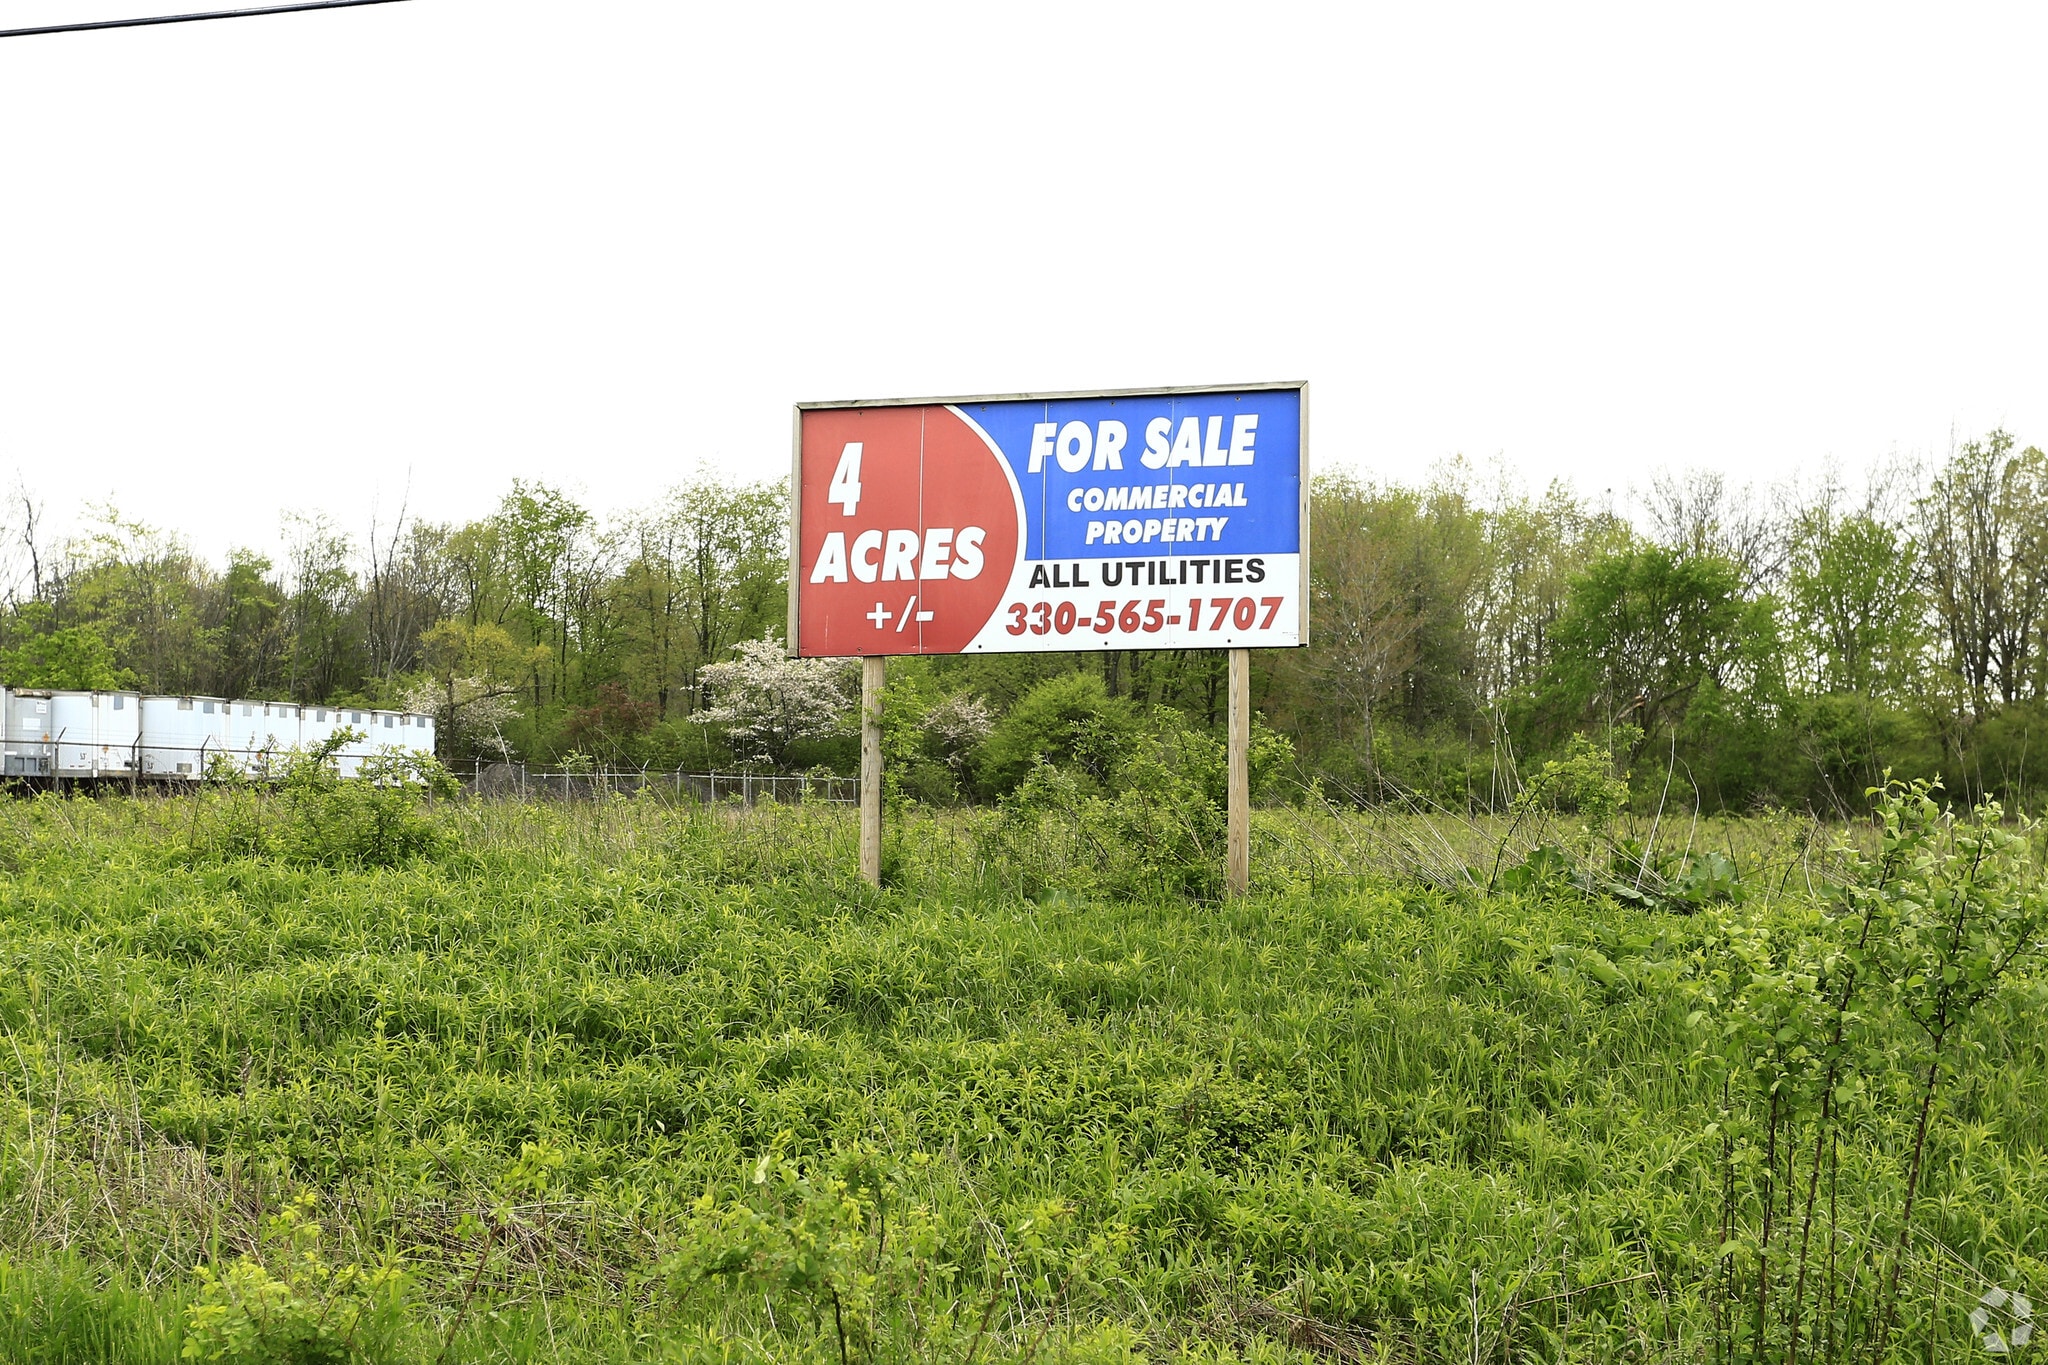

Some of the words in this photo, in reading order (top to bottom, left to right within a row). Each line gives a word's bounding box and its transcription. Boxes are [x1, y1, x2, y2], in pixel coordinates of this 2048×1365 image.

[1027, 419, 1128, 473] FOR
[1140, 414, 1260, 469] SALE
[827, 442, 864, 517] 4
[1066, 482, 1248, 513] COMMERCIAL
[1085, 517, 1229, 545] PROPERTY
[810, 526, 987, 584] ACRES
[1029, 563, 1090, 589] ALL
[1102, 558, 1266, 587] UTILITIES
[866, 595, 934, 633] +/-
[1006, 597, 1284, 636] 330-565-1707
